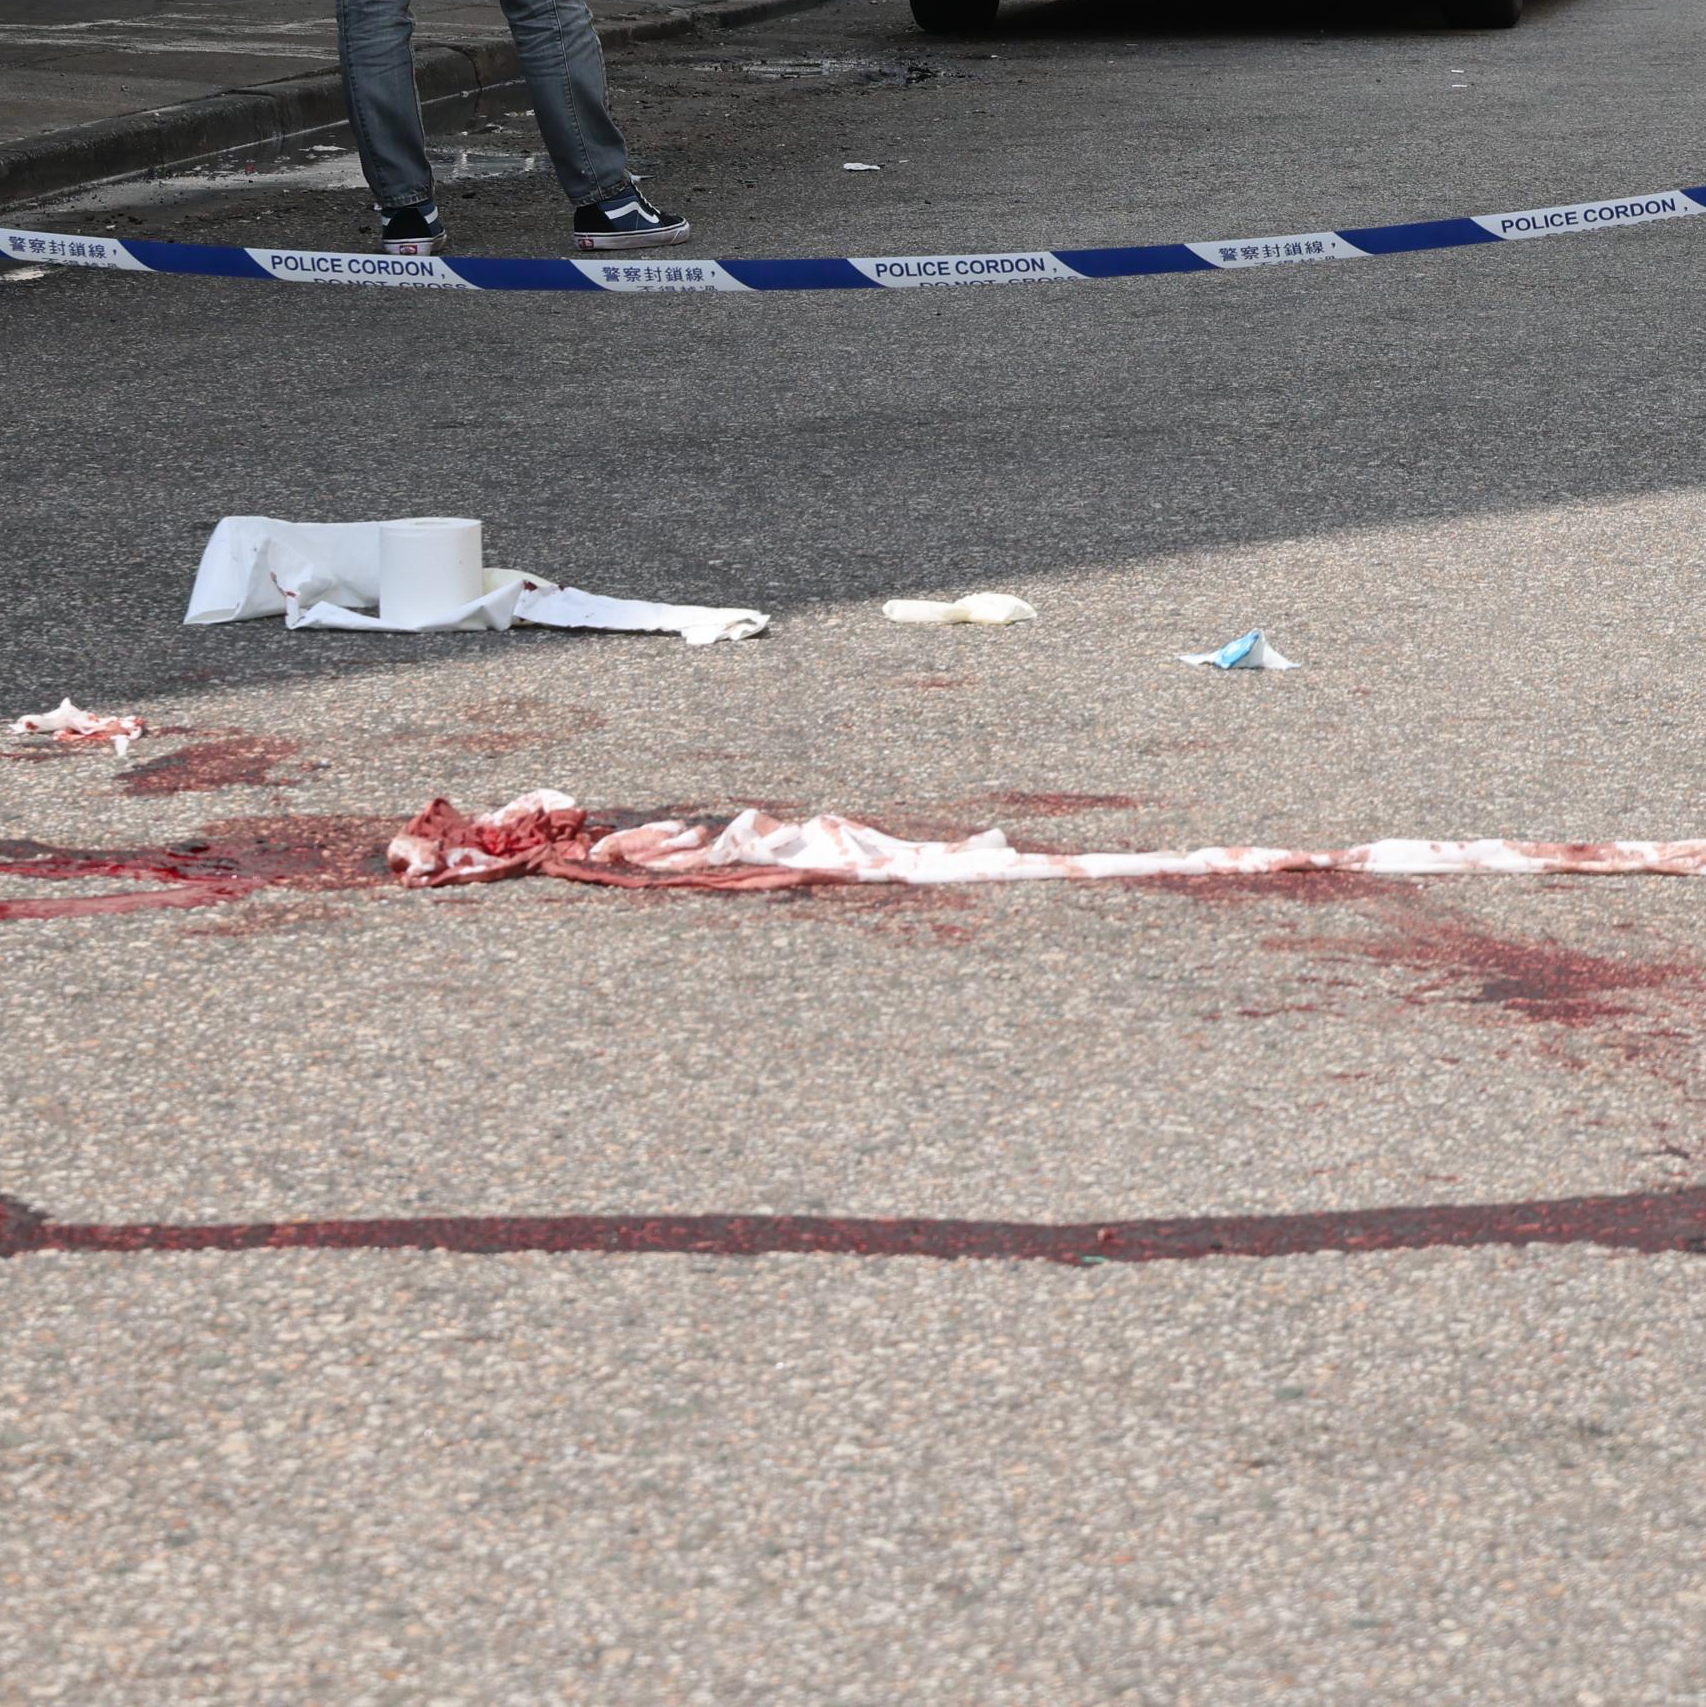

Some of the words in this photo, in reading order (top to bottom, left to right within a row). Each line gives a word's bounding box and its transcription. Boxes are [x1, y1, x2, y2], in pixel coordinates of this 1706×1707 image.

[1501, 211, 1579, 233] POLICE
[271, 255, 343, 273] POLICE
[876, 261, 951, 277] POLICE
